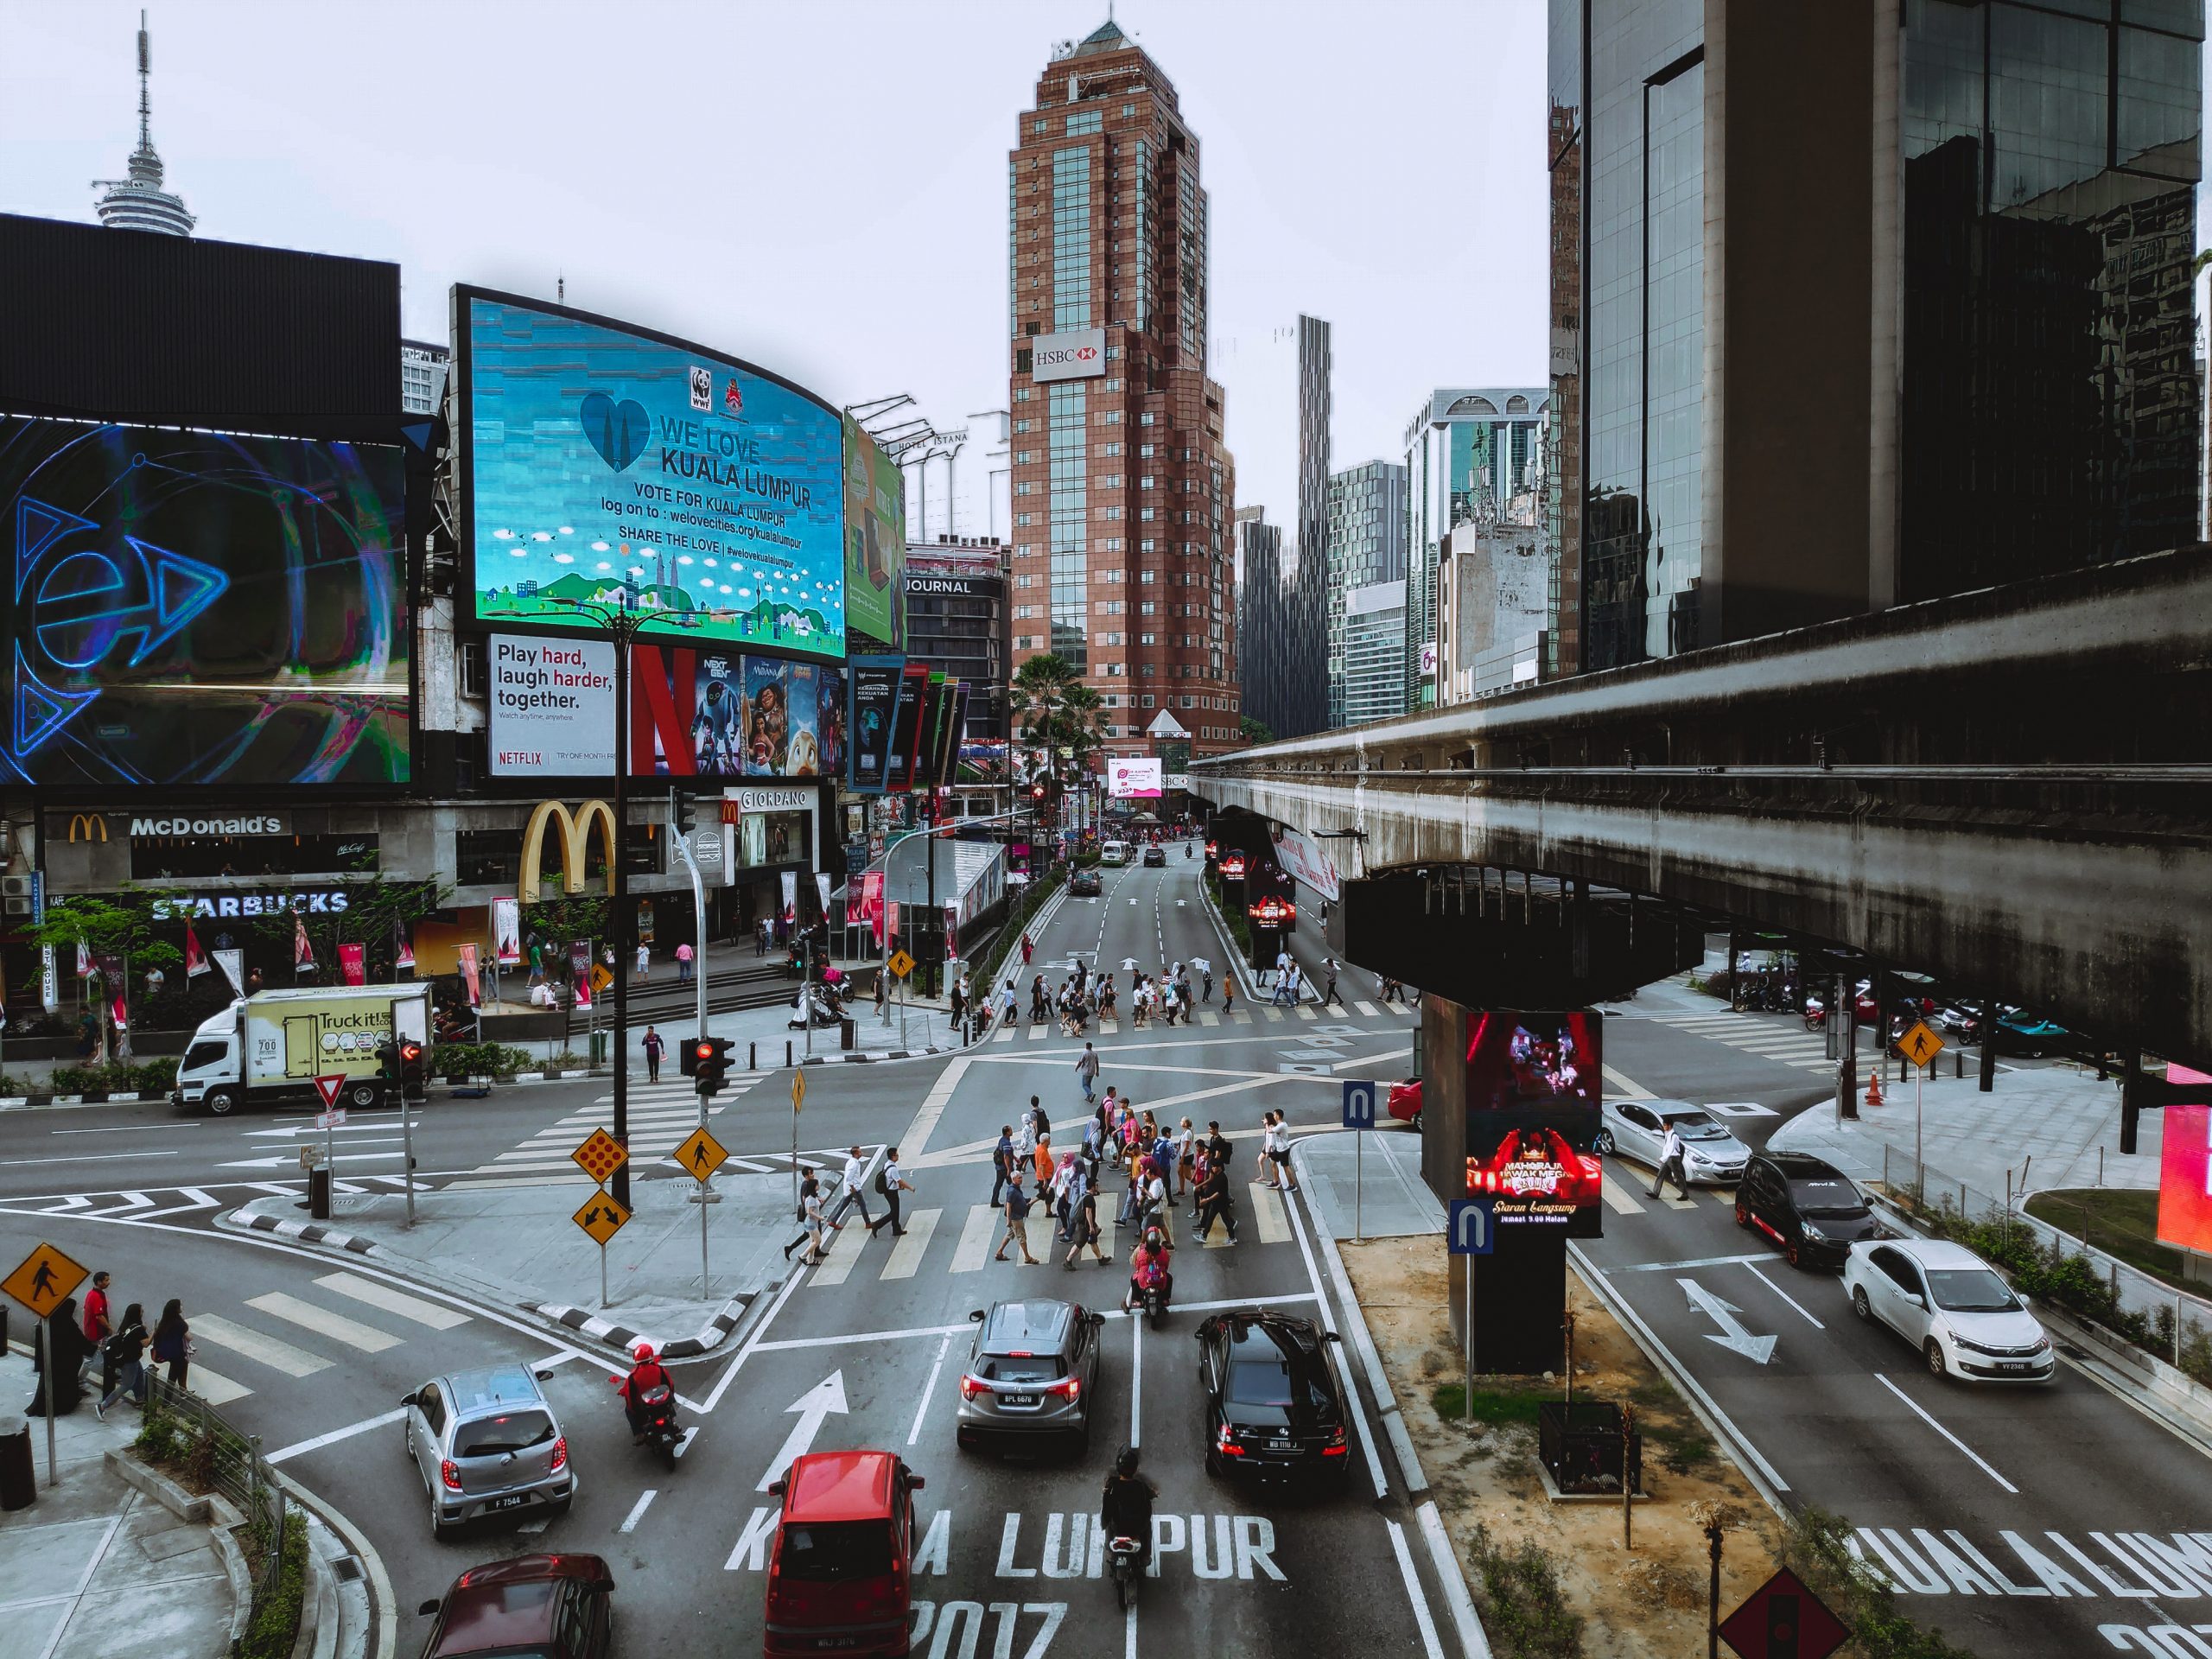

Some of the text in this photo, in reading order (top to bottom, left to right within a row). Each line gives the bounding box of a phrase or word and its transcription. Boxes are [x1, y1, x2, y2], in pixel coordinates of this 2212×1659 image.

[1037, 348, 1075, 365] HSBC
[692, 397, 710, 410] WWF
[659, 415, 760, 465] WE LOVE
[899, 433, 968, 450] HOTEL ISTANA
[661, 446, 741, 489] KUALA
[745, 467, 811, 511] LUMPUR
[633, 481, 786, 529] VOTE FOR KUALA LUMPUR
[601, 496, 622, 515] log
[626, 504, 643, 515] on
[647, 504, 659, 518] to
[670, 510, 802, 550] welovecities.org/kualalumpur
[619, 525, 663, 543] SHARE
[665, 532, 689, 548] THE
[691, 537, 720, 554] LOVE
[727, 545, 794, 569] #welovekualalumpur
[906, 579, 971, 594] JOURNAL
[498, 644, 587, 669] Play hard,
[703, 659, 728, 670] NEXT
[498, 666, 613, 692] laugh harder,
[710, 669, 731, 678] GEN
[753, 664, 779, 677] MOANA
[498, 690, 580, 711] together.
[499, 752, 542, 766] NETFLIX
[1161, 777, 1179, 786] SBC
[742, 791, 807, 809] GIORDANO
[130, 816, 282, 836] McDonald's
[152, 892, 349, 921] STARBUCKS
[320, 1012, 362, 1029] Truck
[365, 1013, 380, 1027] it!
[259, 1041, 276, 1051] 700
[1492, 1200, 1577, 1214] Siaran Langsung
[503, 1496, 521, 1507] 7544
[2043, 1531, 2212, 1599] LUM
